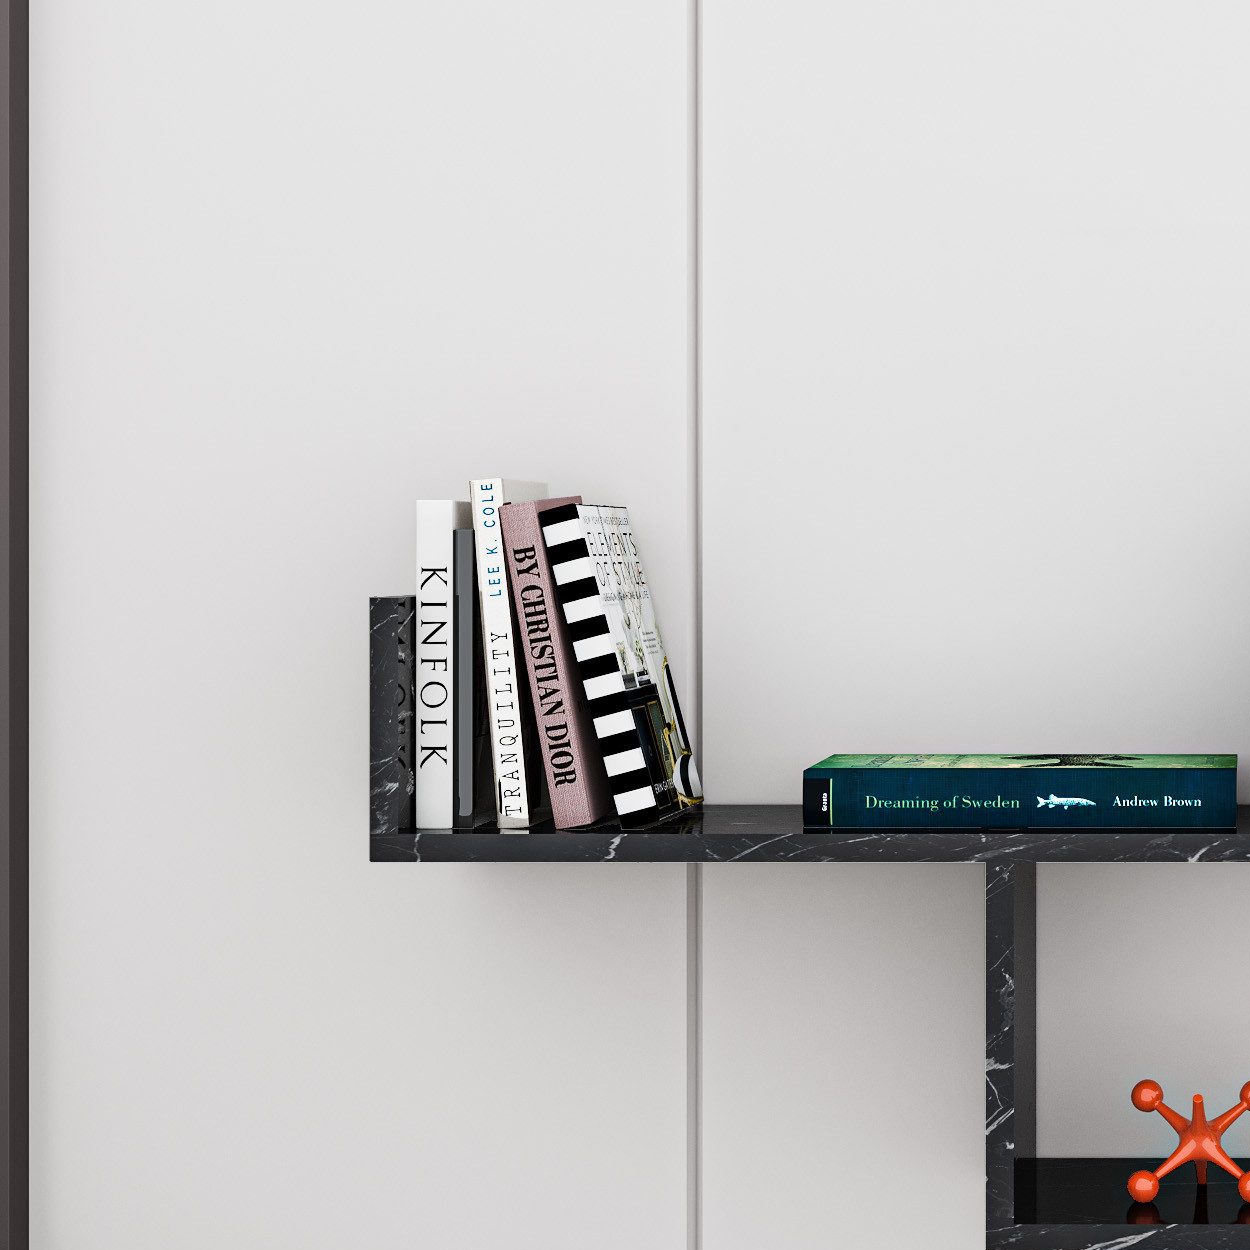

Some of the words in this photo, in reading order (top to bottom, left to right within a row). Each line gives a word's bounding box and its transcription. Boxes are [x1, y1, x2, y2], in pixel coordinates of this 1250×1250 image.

[480, 483, 496, 528] COLE
[486, 567, 502, 597] LEE
[513, 545, 542, 579] BY
[420, 567, 448, 769] KINFOLK
[520, 585, 565, 715] CHRISTIAN
[491, 632, 522, 816] TRANQUILITY
[545, 722, 577, 788] DIOR
[865, 795, 938, 812] Dreaming
[943, 795, 958, 808] of
[961, 795, 1020, 808] Sweden
[1112, 796, 1159, 807] Andrew
[1163, 796, 1202, 807] Brown
